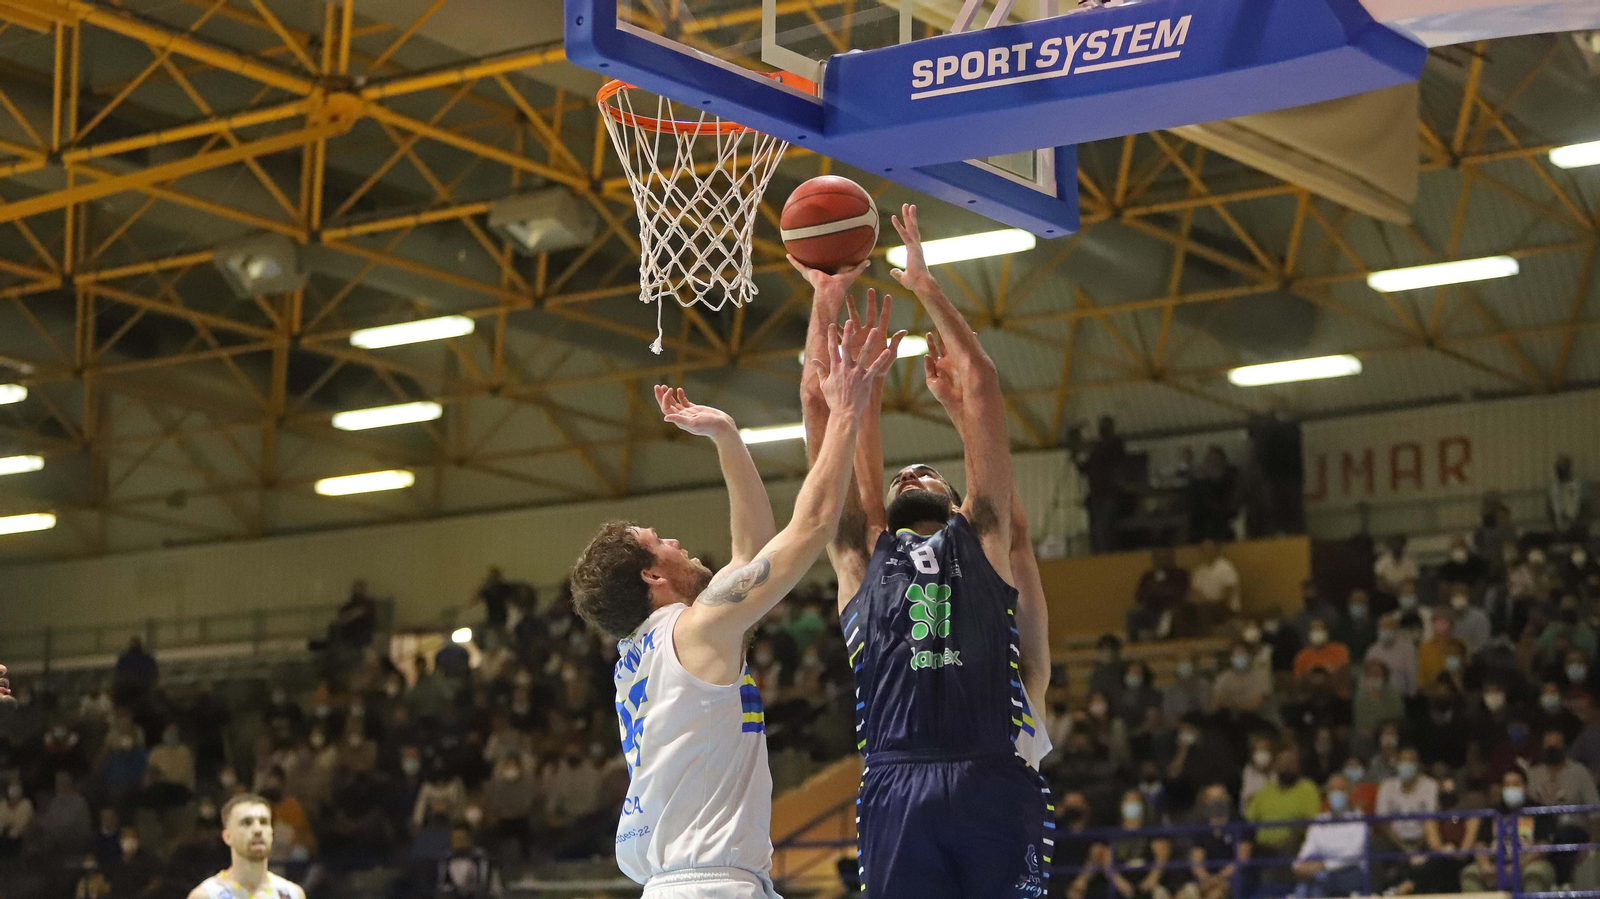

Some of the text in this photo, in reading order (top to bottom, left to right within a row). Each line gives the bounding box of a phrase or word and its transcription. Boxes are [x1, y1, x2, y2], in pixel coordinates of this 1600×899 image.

[911, 14, 1193, 89] SPORT SYSTEM
[909, 545, 940, 575] 8
[621, 796, 644, 816] CA
